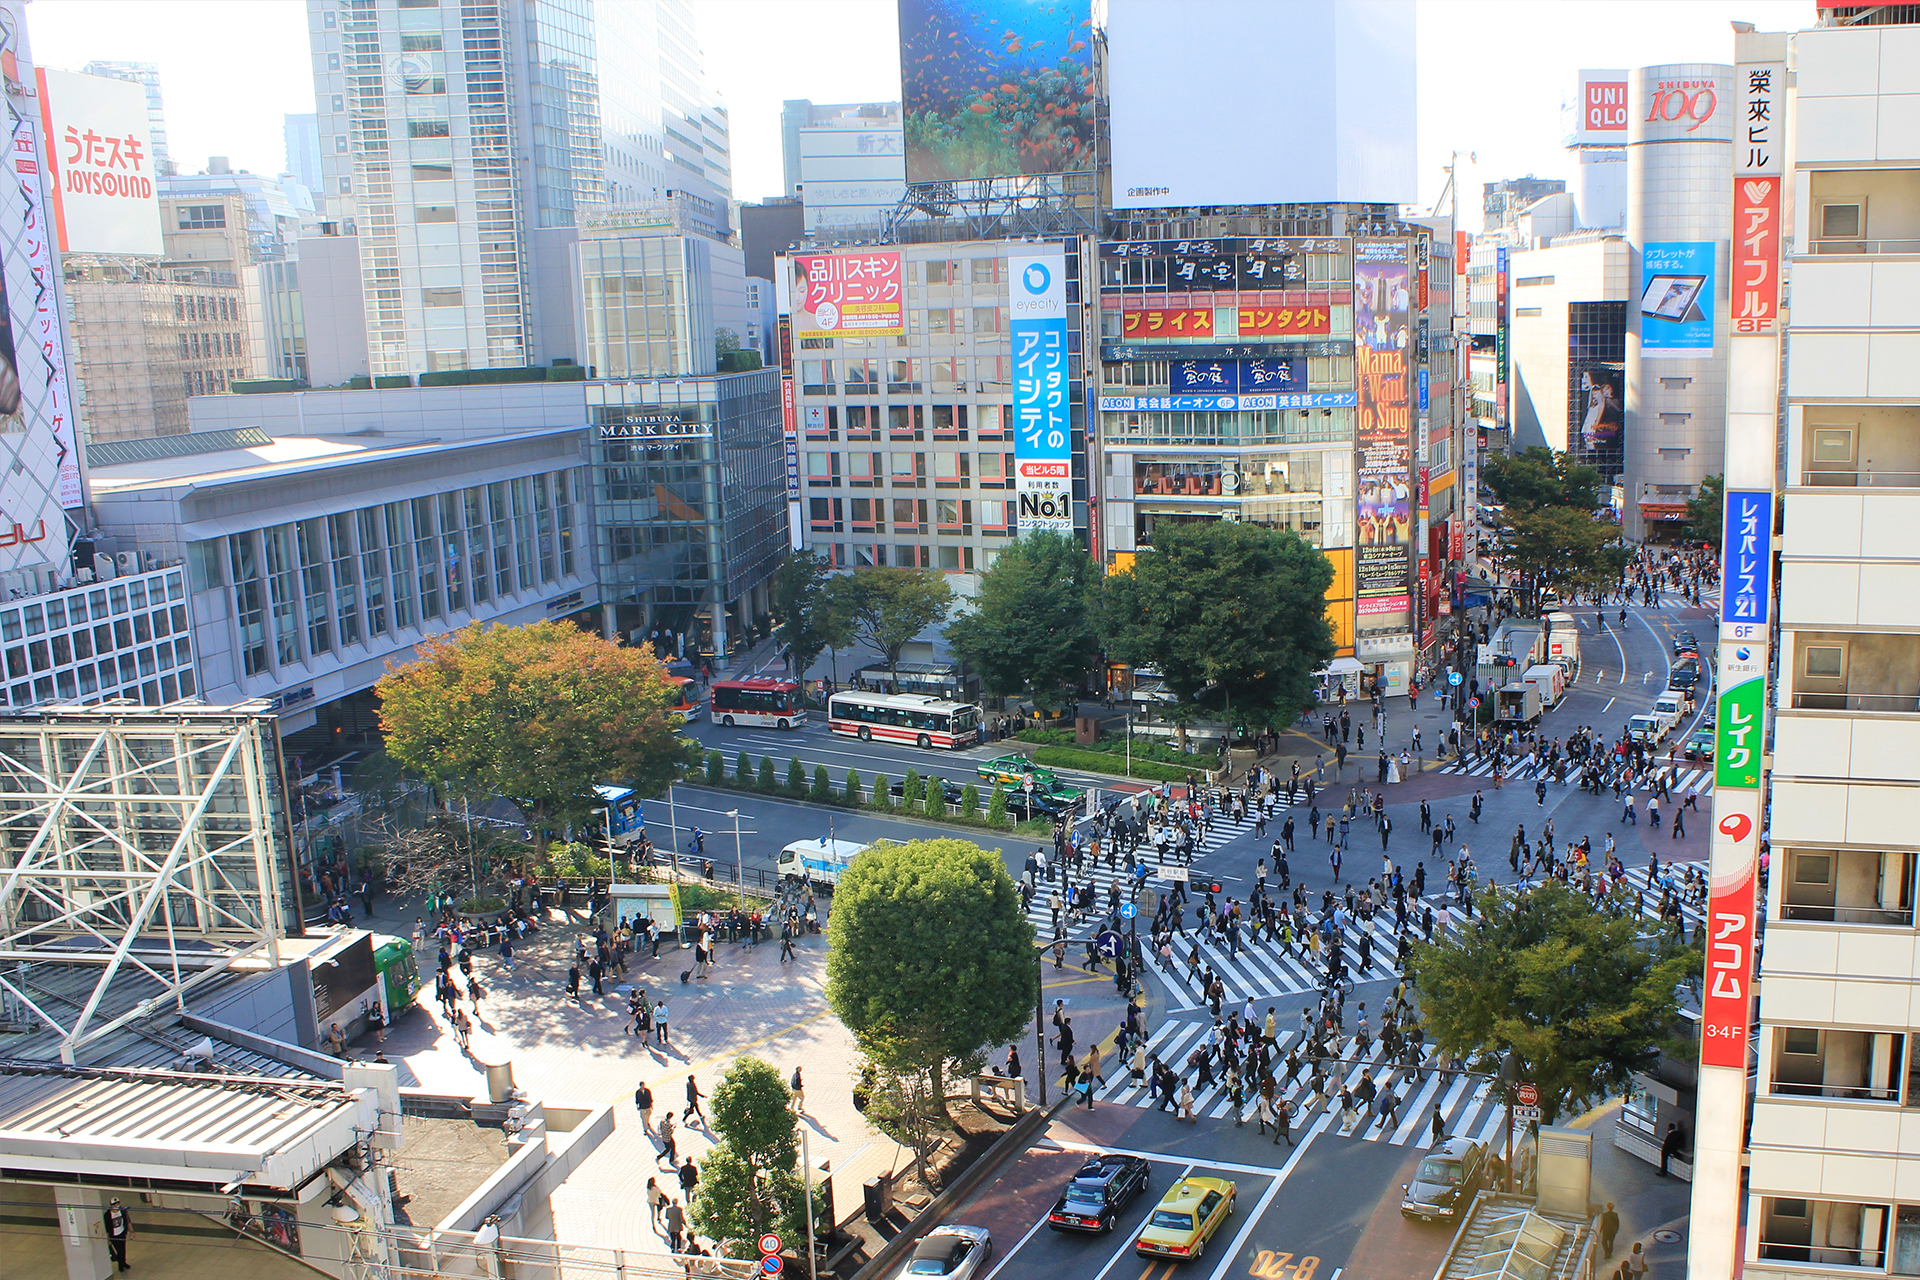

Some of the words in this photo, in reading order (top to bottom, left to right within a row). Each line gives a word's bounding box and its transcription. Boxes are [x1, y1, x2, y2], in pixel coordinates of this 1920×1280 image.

[1658, 80, 1715, 90] SHIBUYA
[1590, 87, 1624, 104] UNI
[1590, 108, 1627, 128] QLO
[1644, 89, 1718, 132] 109
[64, 125, 145, 171] うたスキ
[857, 134, 903, 154] 新大
[66, 169, 151, 199] JOYSOUND
[1127, 187, 1170, 197] 企画製作中
[1646, 249, 1695, 259] タブレットが
[810, 256, 899, 282] 品川スキン
[1741, 208, 1770, 317] アイフル
[811, 279, 899, 304] クリニック
[1016, 298, 1059, 313] eyecity
[821, 318, 833, 327] 4F
[1125, 311, 1212, 331] プライス
[1239, 308, 1328, 329] コンタクト
[1737, 319, 1772, 333] 8F
[1225, 347, 1234, 355] 7F
[1243, 347, 1252, 355] 7F
[1357, 346, 1407, 375] Mama,
[1018, 331, 1042, 449] アイシティ
[1045, 331, 1064, 449] コンタクトの
[1358, 374, 1365, 402] I
[1368, 375, 1406, 402] Want
[1102, 397, 1132, 408] AEON
[1137, 395, 1214, 409] 英会話イーオン
[1220, 399, 1232, 408] 6F
[1243, 396, 1273, 408] AEON
[1279, 394, 1355, 408] 英会話イーオン
[626, 415, 681, 423] SHIBUYA
[1358, 404, 1374, 430] to
[1376, 401, 1409, 432] Sing
[600, 425, 657, 437] MARK
[666, 423, 713, 435] CITY
[1025, 465, 1065, 477] 当ビル5階
[1028, 481, 1059, 489] 利用者数
[1018, 490, 1071, 520] No.1
[1019, 520, 1071, 529] コンタクトショップ
[1466, 505, 1475, 555] マルナン
[1734, 498, 1759, 618] レオパレス21
[1734, 626, 1753, 638] 6F
[1727, 663, 1758, 672] 新生銀行
[1727, 702, 1753, 768] レイク
[1744, 775, 1757, 784] 5F
[1711, 912, 1746, 1000] アコム
[763, 1238, 777, 1250] 40
